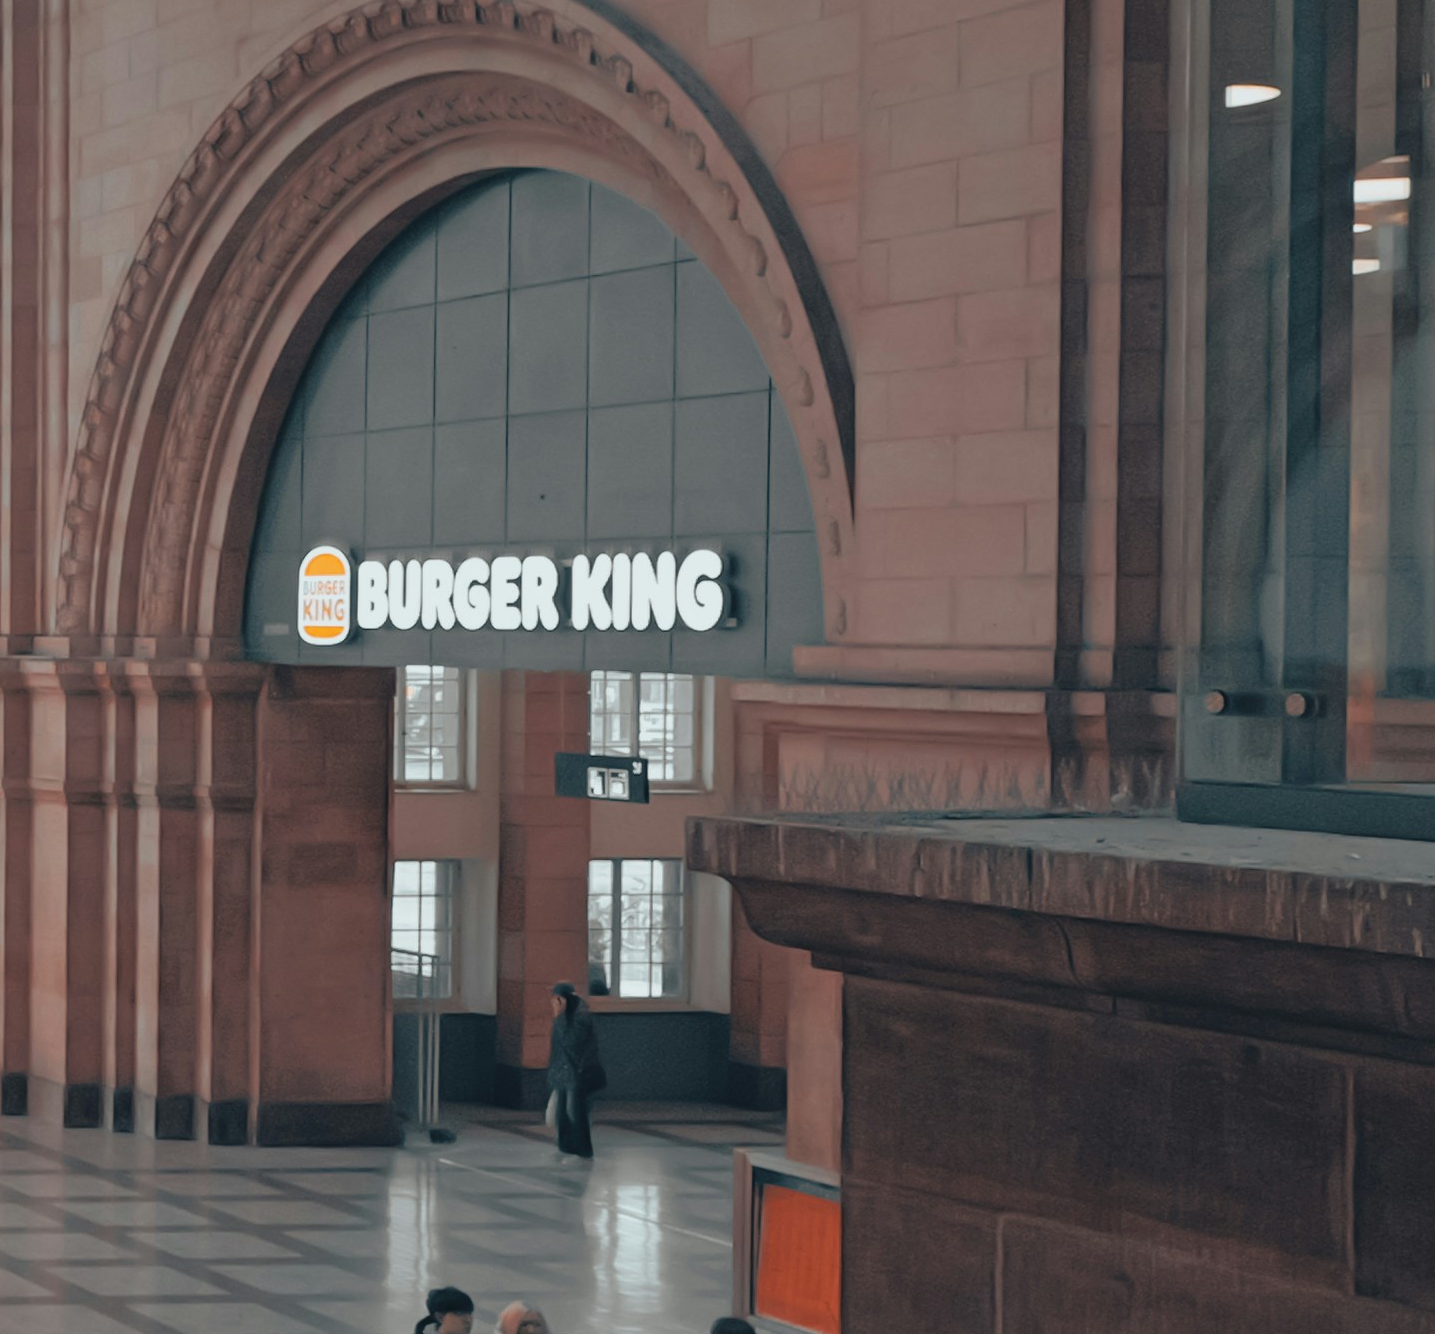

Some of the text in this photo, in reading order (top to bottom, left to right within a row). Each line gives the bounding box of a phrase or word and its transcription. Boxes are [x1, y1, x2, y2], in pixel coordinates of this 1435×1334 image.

[302, 580, 346, 595] BURGER
[356, 548, 724, 633] BURGER KING
[302, 598, 345, 621] KING
